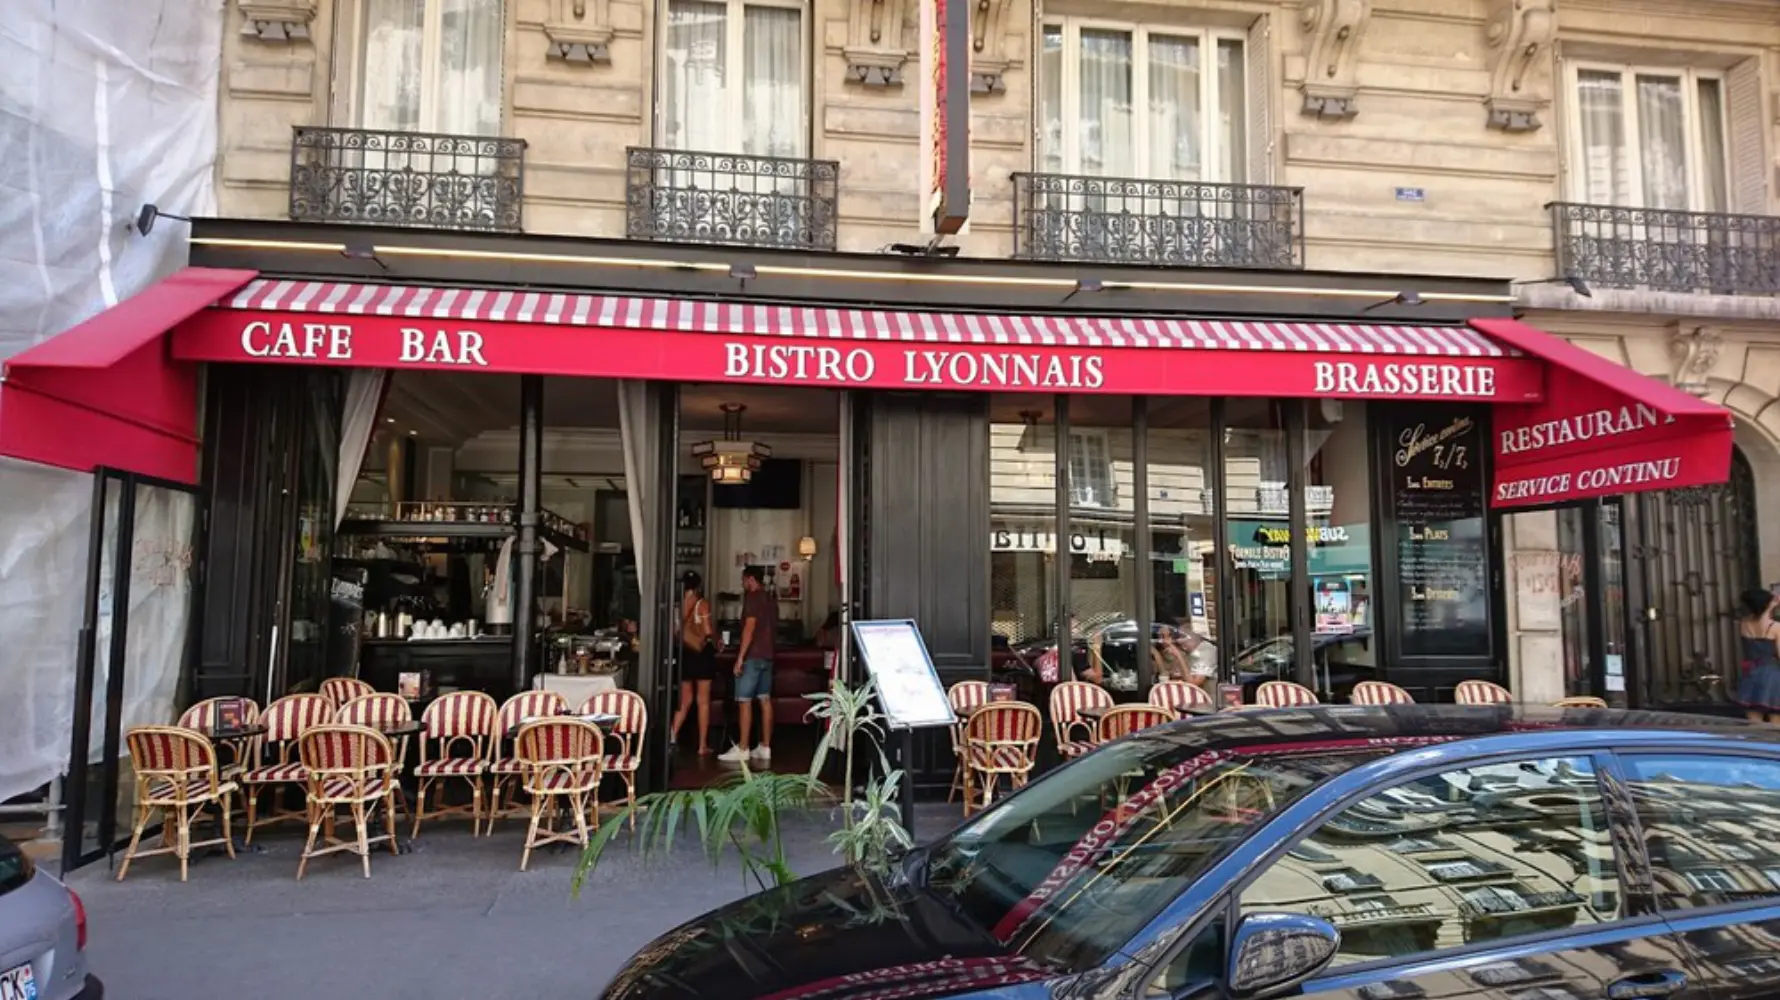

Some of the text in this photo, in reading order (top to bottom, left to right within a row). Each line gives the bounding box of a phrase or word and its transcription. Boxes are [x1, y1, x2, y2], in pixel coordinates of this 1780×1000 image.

[241, 321, 488, 366] CAFE BAR
[724, 342, 1104, 389] BISTRO LYONNAIS
[1314, 361, 1496, 396] BRASSERIE
[1497, 457, 1682, 501] SERVICE CONTINU
